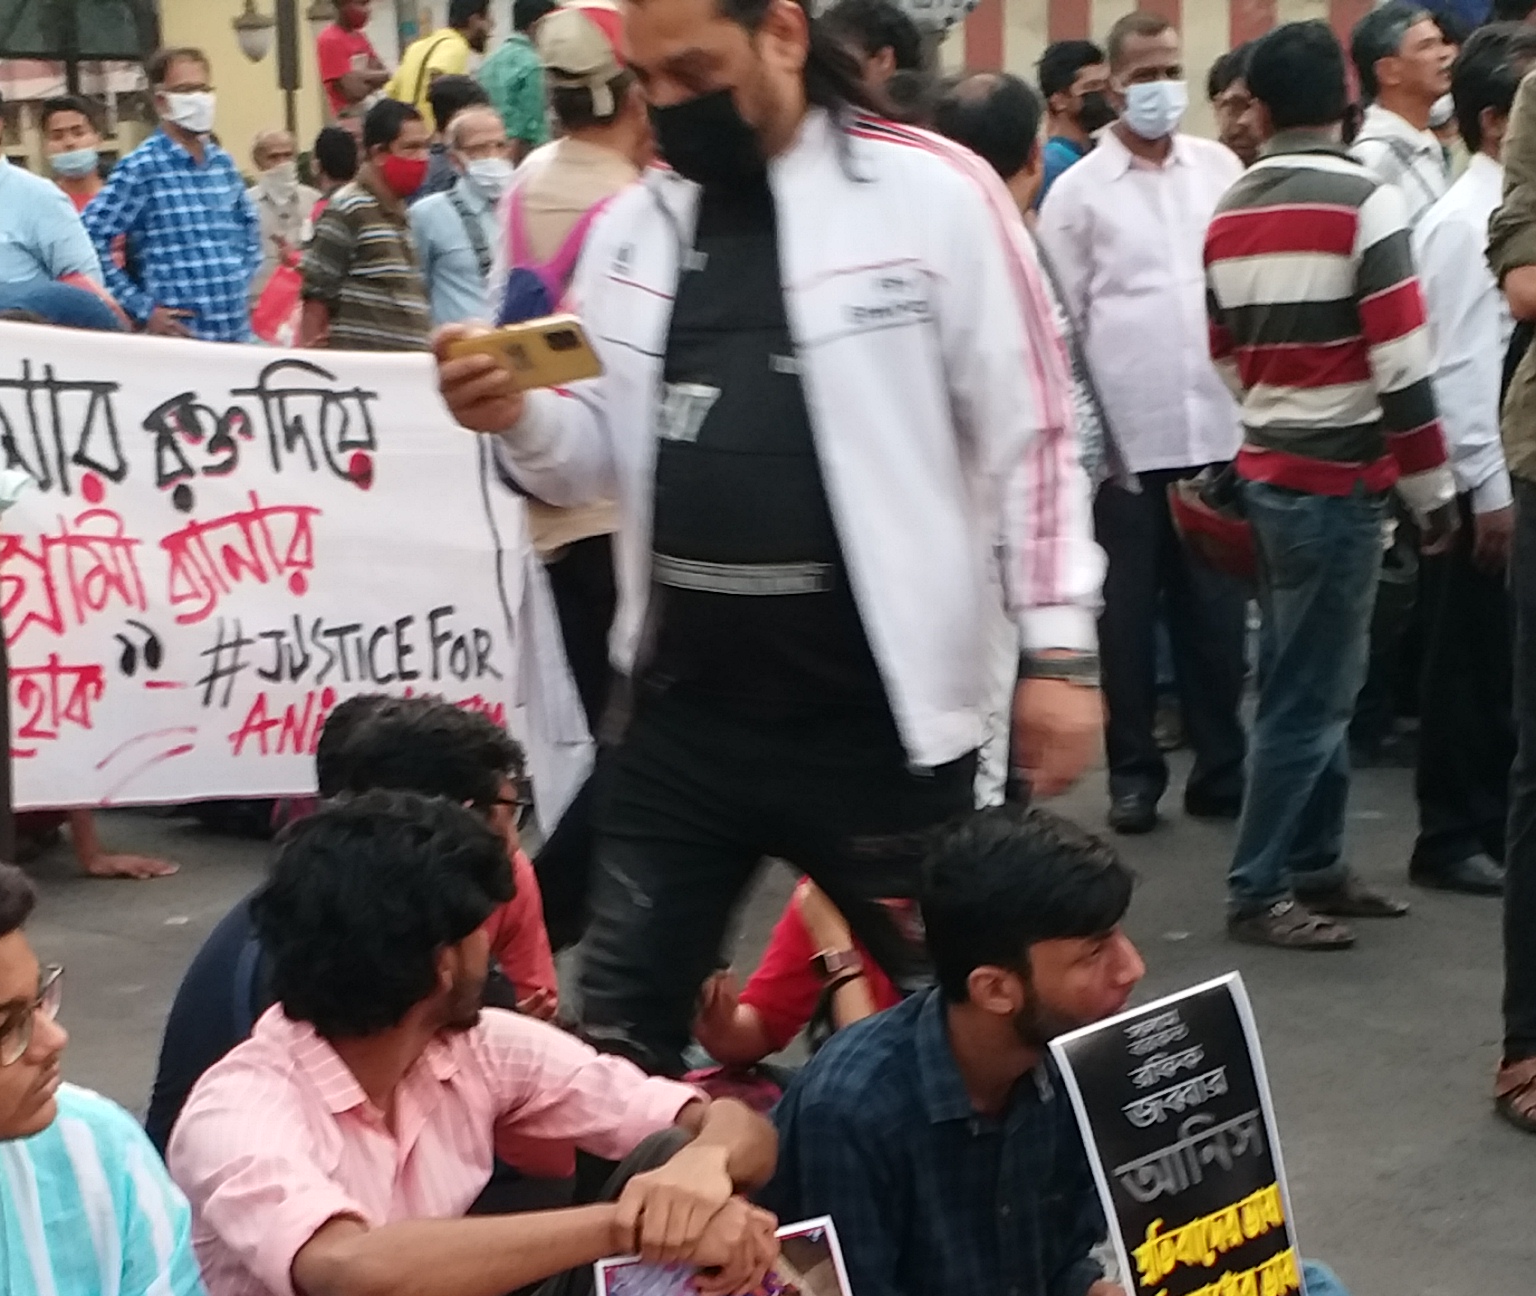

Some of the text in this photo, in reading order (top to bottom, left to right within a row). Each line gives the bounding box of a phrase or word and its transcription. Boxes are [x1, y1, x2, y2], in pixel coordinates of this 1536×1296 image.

[159, 491, 324, 623] ব্যানার
[195, 612, 421, 708] #JUSTICE
[427, 604, 503, 682] FOR
[1112, 1108, 1264, 1203] আনিস
